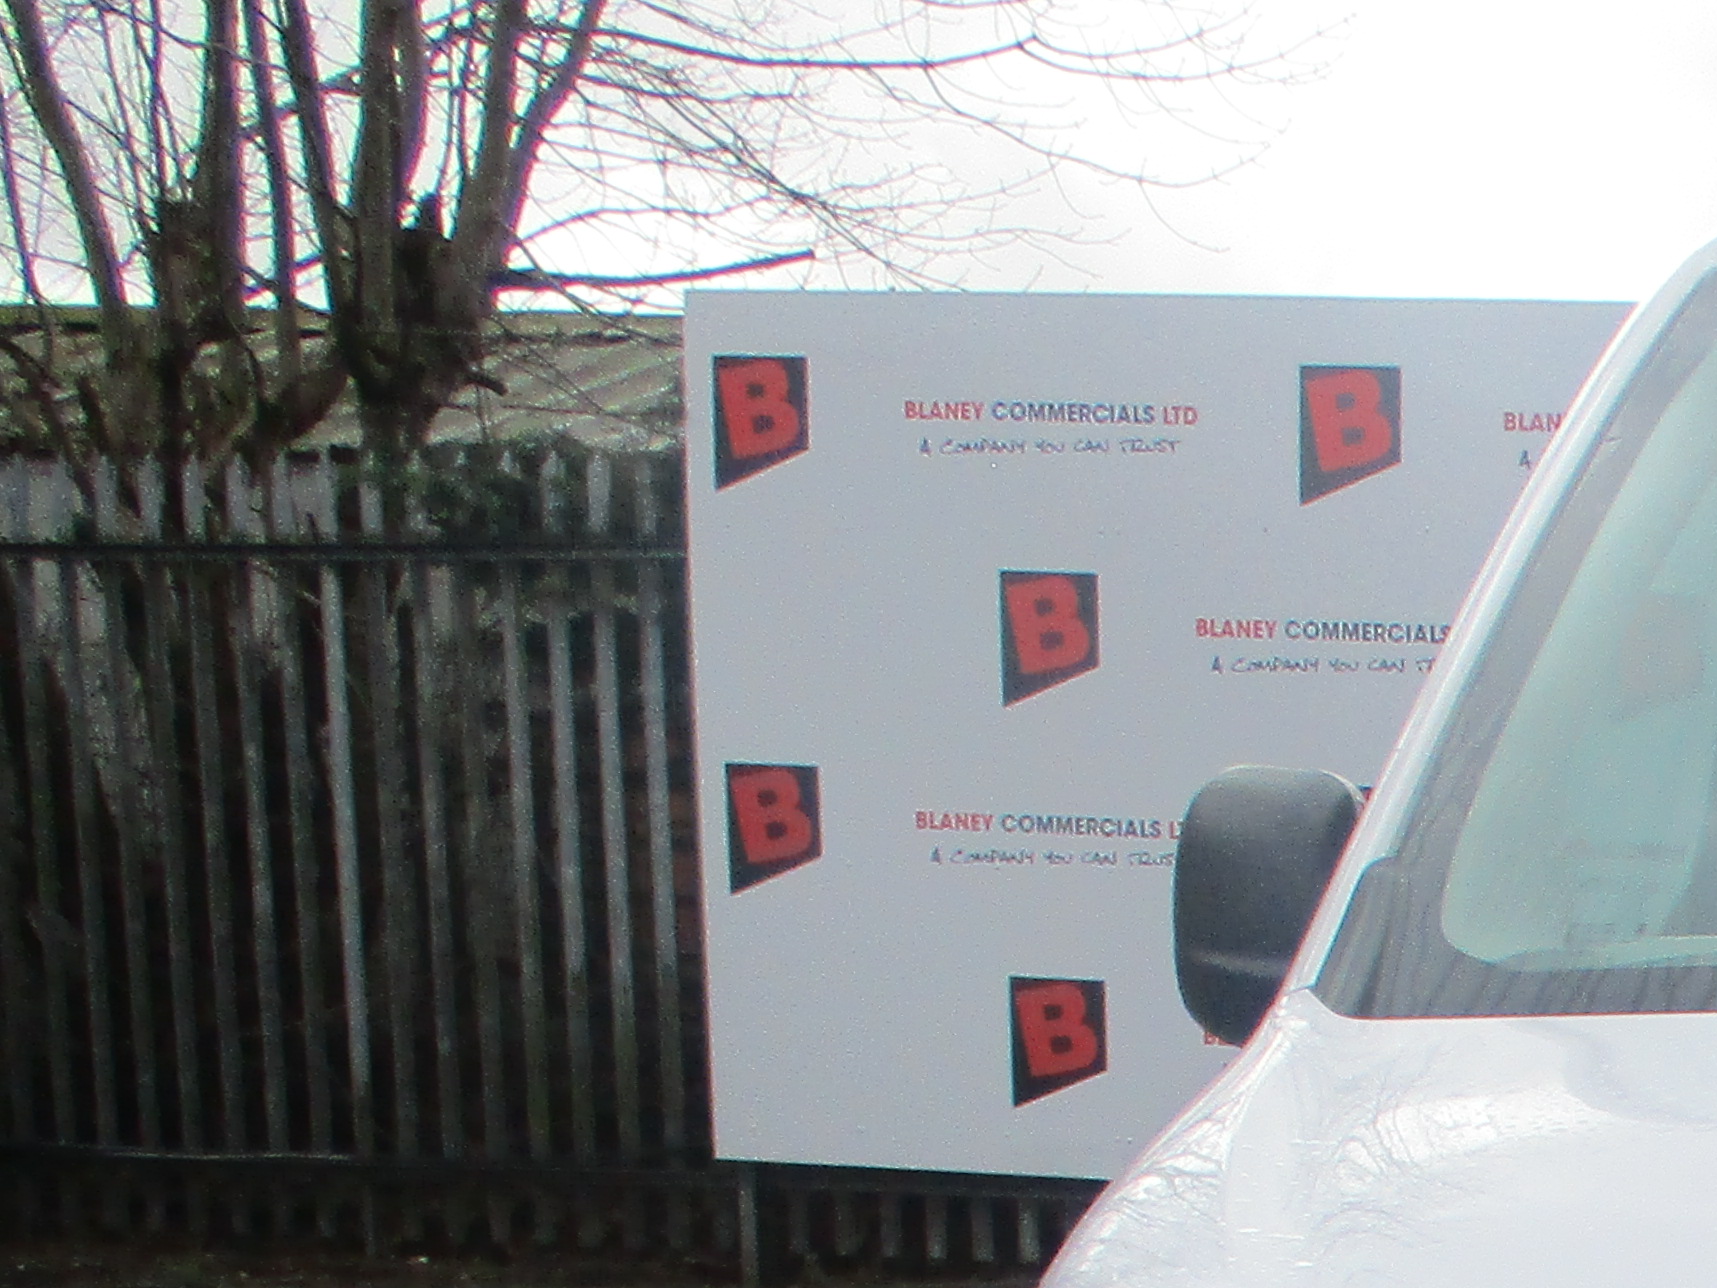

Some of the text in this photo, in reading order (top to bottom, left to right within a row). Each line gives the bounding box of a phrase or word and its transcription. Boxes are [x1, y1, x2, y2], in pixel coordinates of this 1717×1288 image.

[719, 359, 799, 459] B
[904, 401, 1198, 426] BLANEY COMMERCIALS LTD
[1305, 370, 1393, 472] B
[1504, 411, 1562, 432] BLAN
[939, 438, 1027, 454] COMPANY
[1074, 438, 1108, 454] CAN
[1119, 439, 1181, 453] TRUST
[1005, 576, 1090, 674] B
[1195, 618, 1277, 640] BLANEY
[1211, 656, 1224, 674] A
[1232, 657, 1319, 673] COMPANY
[1368, 658, 1406, 674] CAN
[730, 769, 812, 864] B
[914, 811, 994, 832] BLANEY
[1001, 814, 1162, 839] COMMERCIALS
[950, 848, 1036, 865] COMPANY
[1081, 851, 1118, 866] CAN
[1127, 852, 1176, 867] TRUS
[1015, 982, 1098, 1077] B
